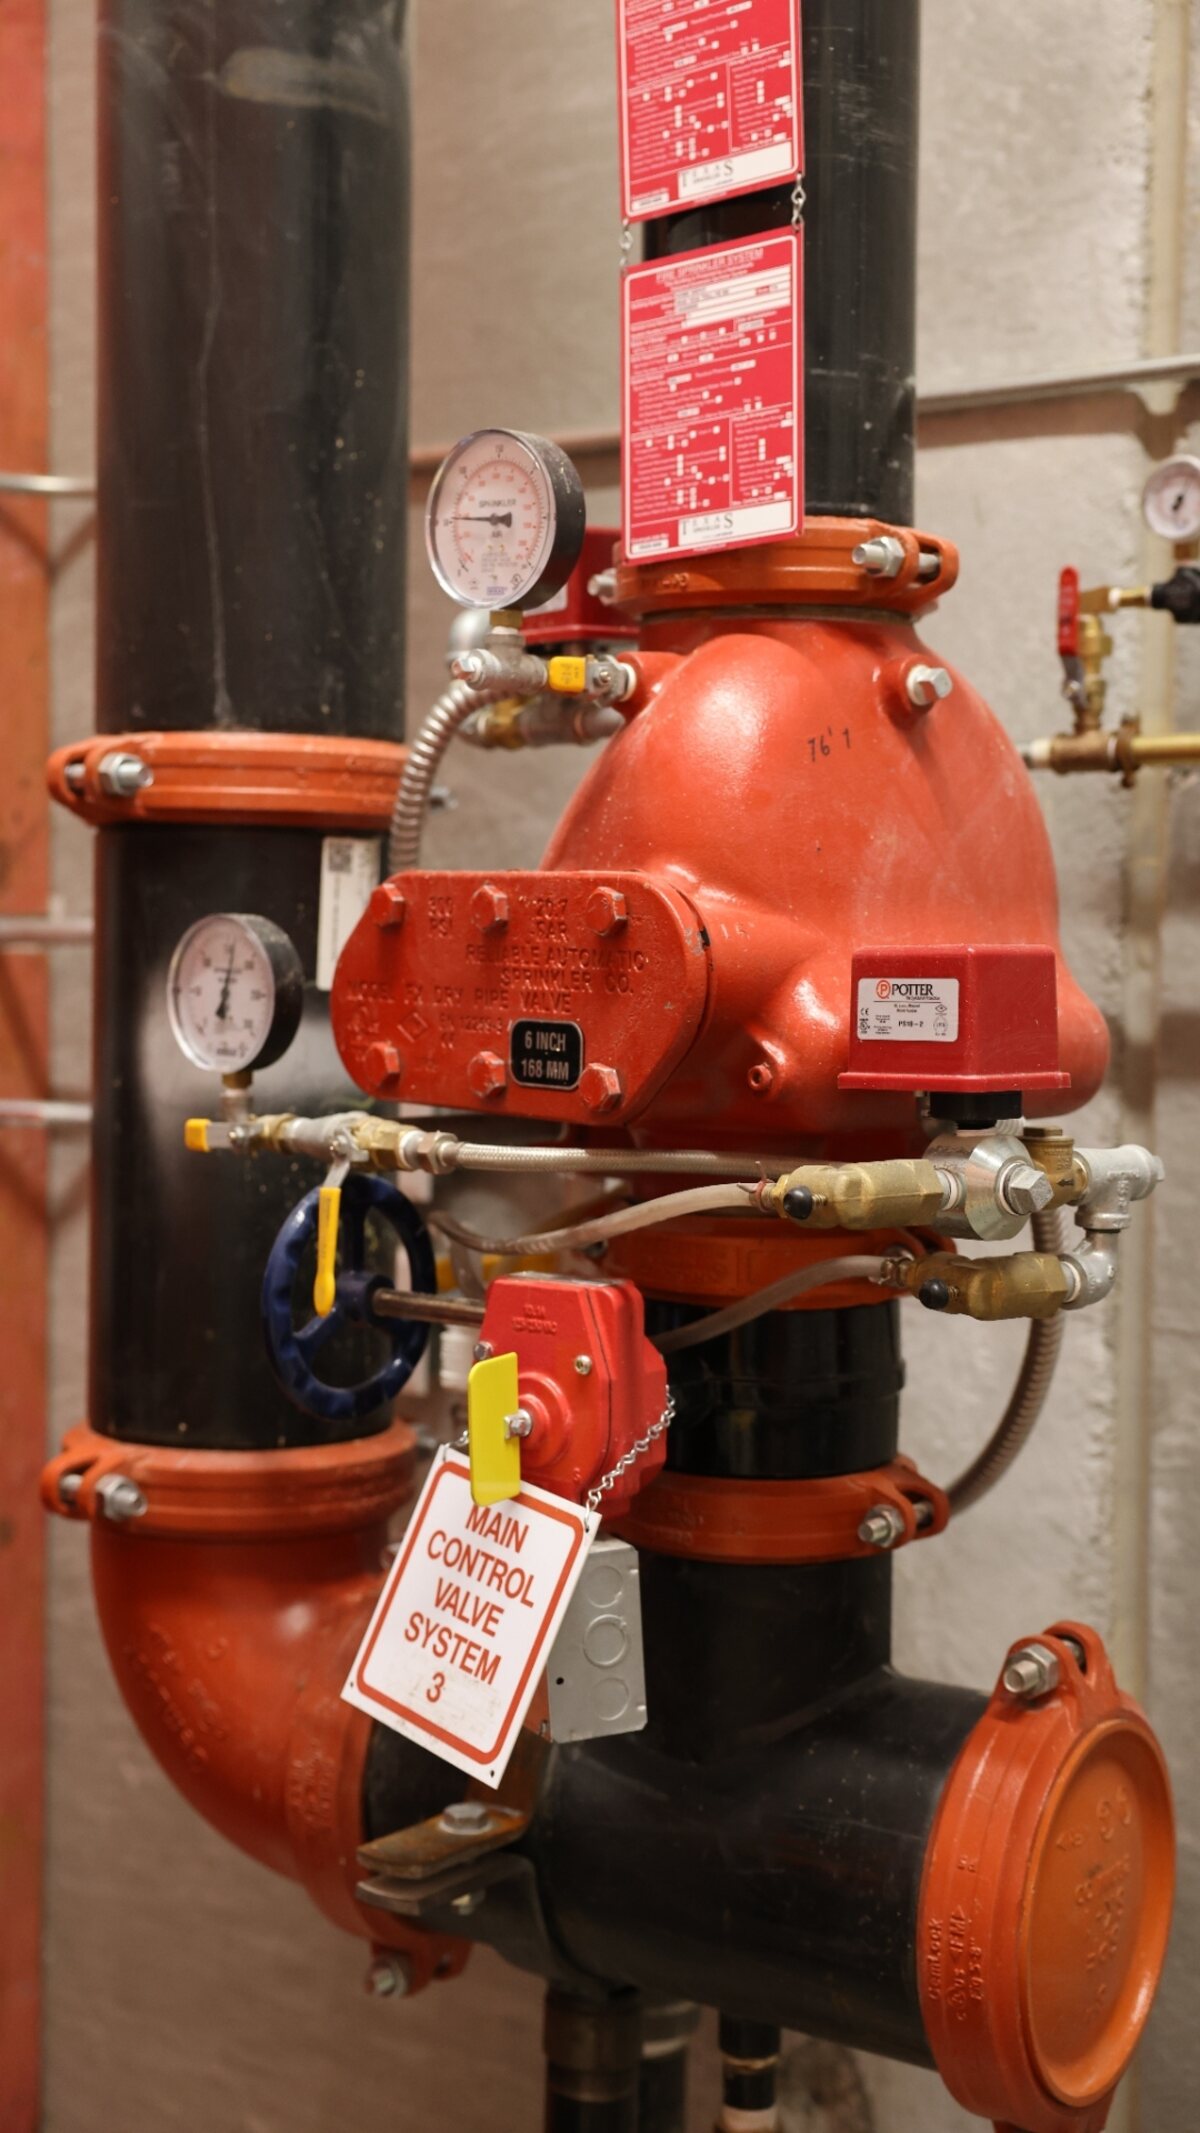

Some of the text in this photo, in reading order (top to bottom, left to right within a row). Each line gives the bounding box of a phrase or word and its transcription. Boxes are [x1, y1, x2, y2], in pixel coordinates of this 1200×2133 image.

[501, 967, 593, 993] SPRINKLER
[891, 983, 934, 996] POTTER
[519, 990, 572, 1015] VALVE
[524, 1030, 567, 1052] 6 INCH
[521, 1058, 570, 1081] 168 MM
[465, 1505, 530, 1553] MAIN
[426, 1530, 535, 1608] CONTROL
[434, 1577, 505, 1637] VALVE
[404, 1612, 502, 1685] SYSTEM
[426, 1672, 446, 1703] 3
